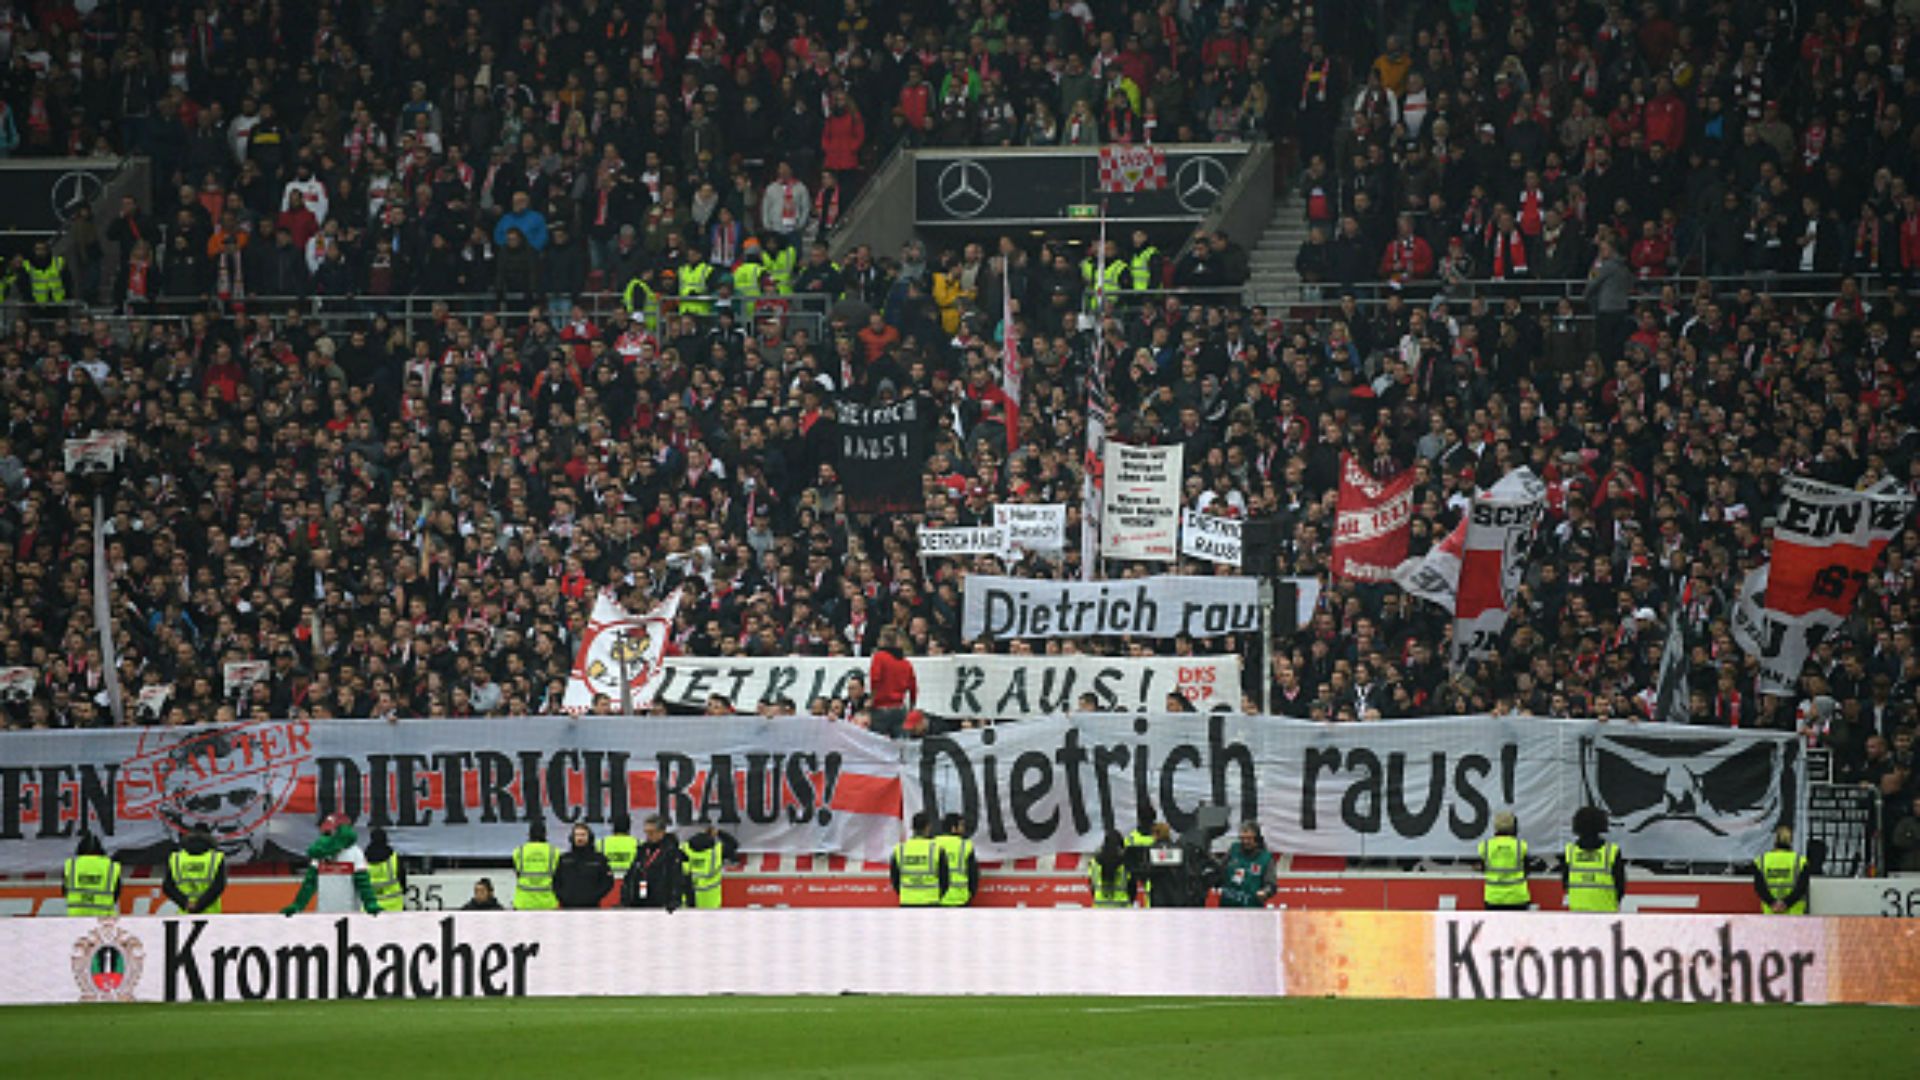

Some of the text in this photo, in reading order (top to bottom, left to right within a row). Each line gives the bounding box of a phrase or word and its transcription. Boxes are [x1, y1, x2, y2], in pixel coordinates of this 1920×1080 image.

[983, 585, 1260, 636] Dietrich rau
[0, 750, 842, 839] FEN DIETRICH RAUS!
[122, 721, 312, 800] SPALTER
[917, 719, 1518, 845] Dietrich raus!
[163, 917, 540, 1000] Krombacher
[1447, 920, 1815, 1003] Krombacher
